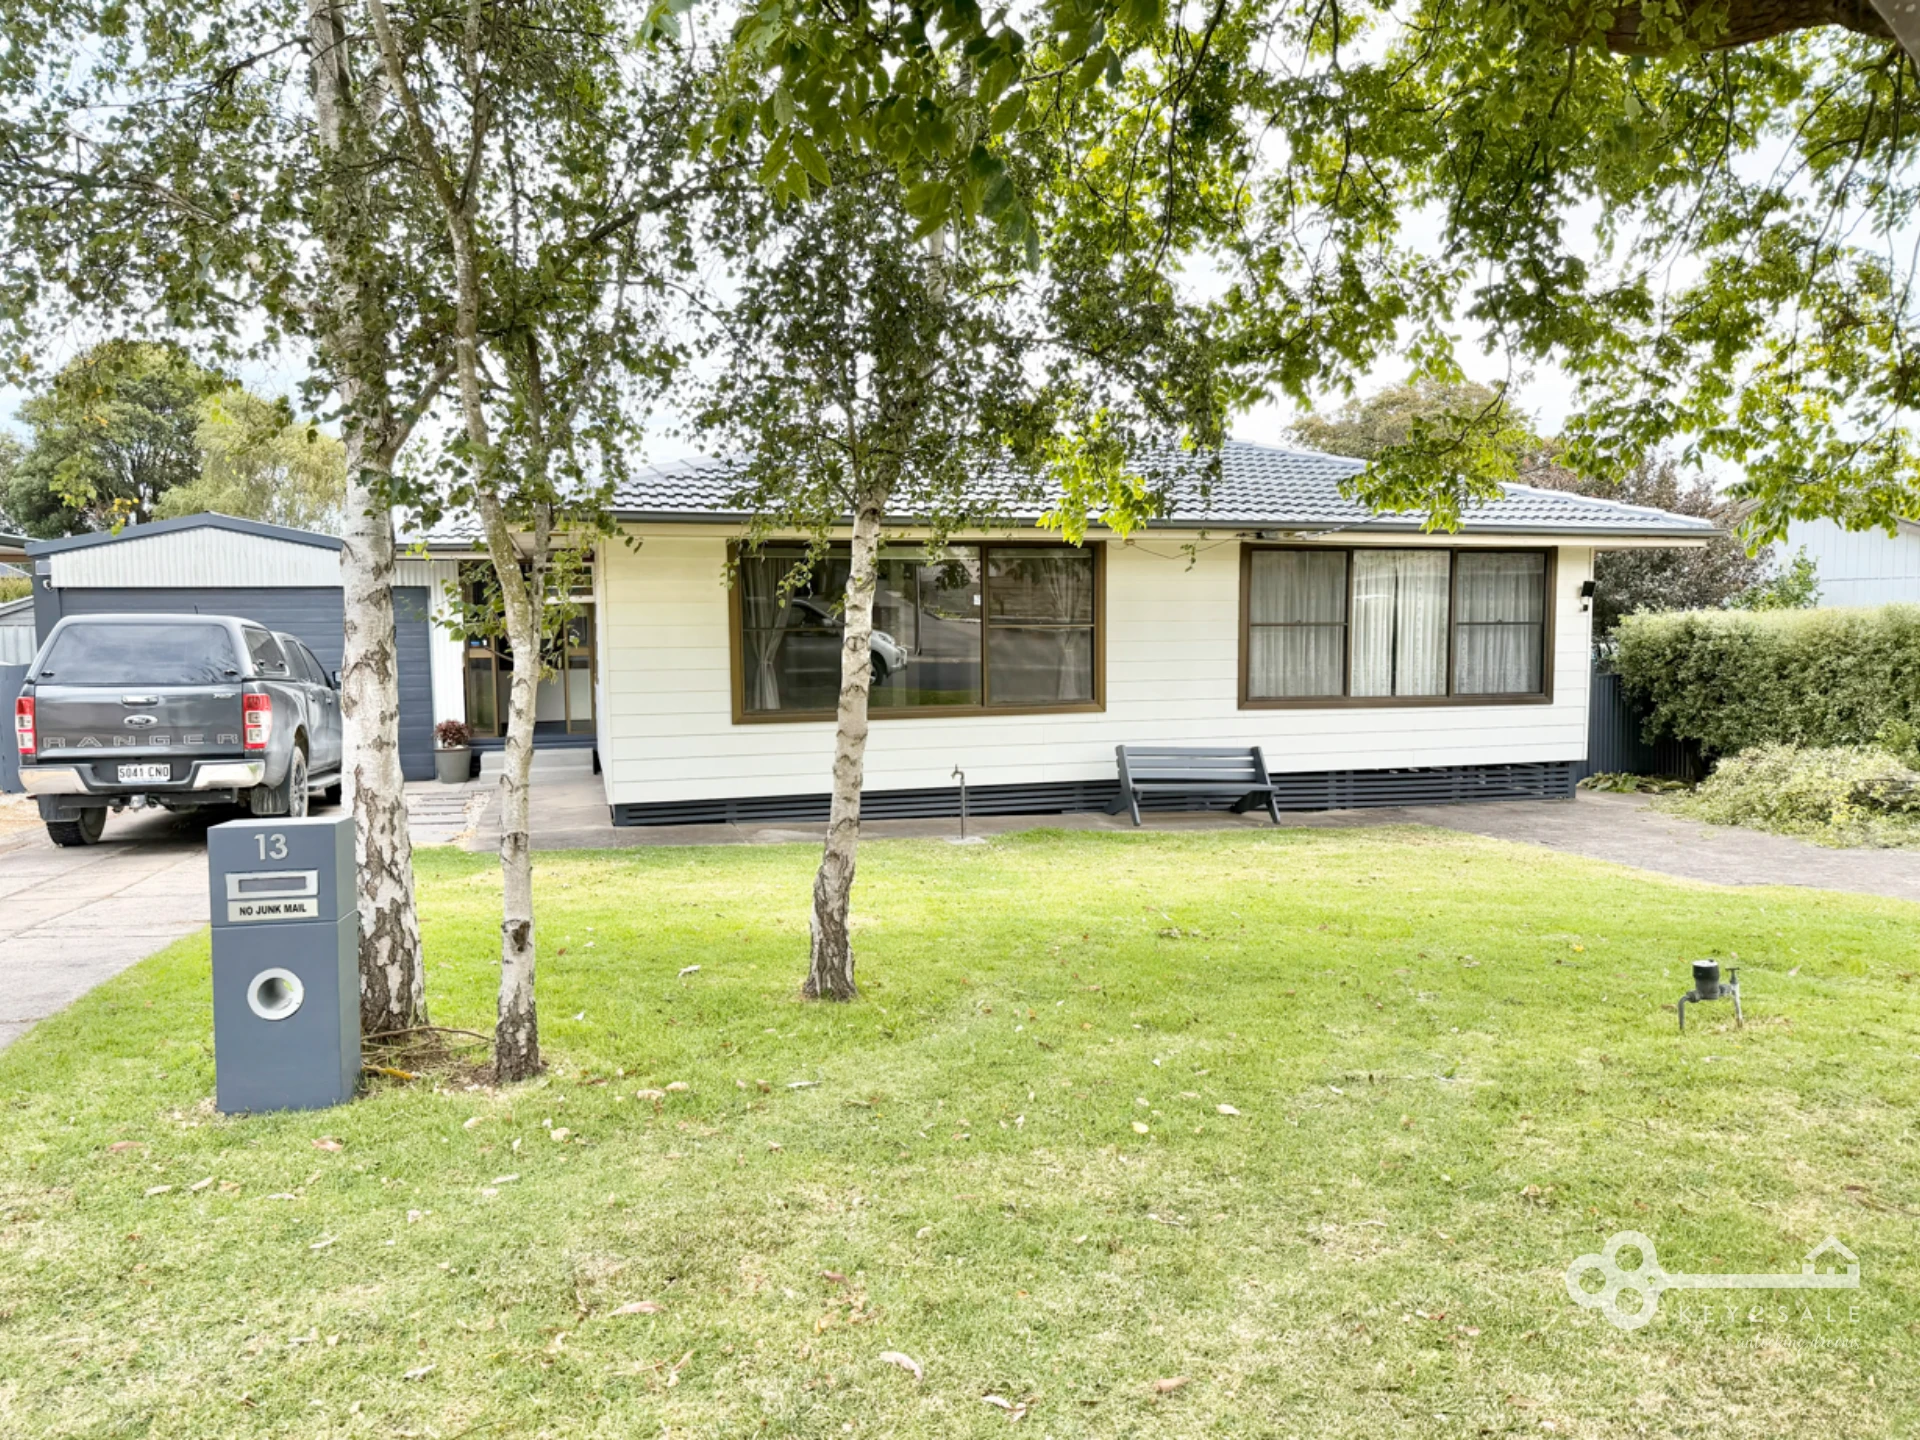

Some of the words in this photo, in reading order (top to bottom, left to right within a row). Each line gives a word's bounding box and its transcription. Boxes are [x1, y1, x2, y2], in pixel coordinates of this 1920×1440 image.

[43, 734, 239, 748] RANGER
[254, 833, 288, 860] 13
[239, 906, 253, 916] NO
[256, 904, 281, 915] JUNK
[284, 903, 306, 913] MAIL
